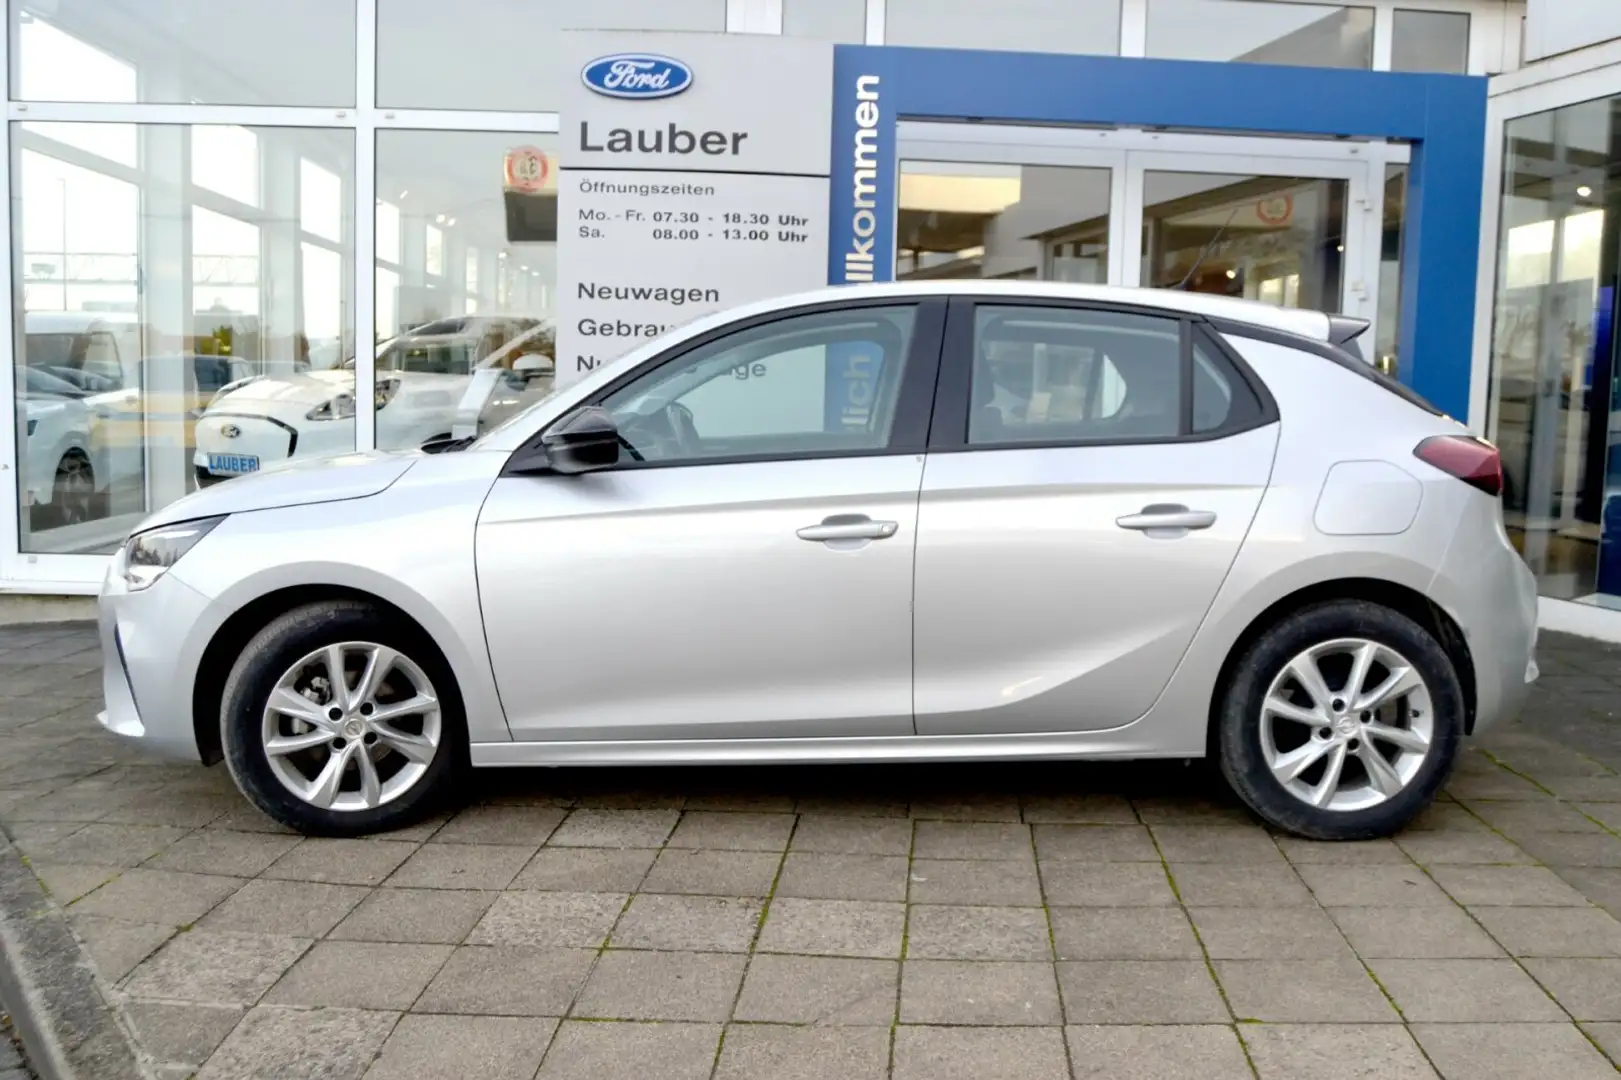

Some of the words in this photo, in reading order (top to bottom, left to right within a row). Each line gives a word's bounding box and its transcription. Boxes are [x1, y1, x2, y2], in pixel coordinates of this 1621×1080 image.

[603, 60, 672, 89] Ford
[580, 121, 748, 155] Lauber
[579, 178, 715, 196] Öffnungszeiten
[845, 75, 880, 281] llkommen
[652, 211, 699, 223] 07.30
[723, 212, 770, 225] 18.30
[777, 214, 809, 226] Uhr
[578, 225, 605, 238] Sa.
[652, 228, 699, 240] 08.00
[723, 229, 770, 241] 13.00
[777, 230, 808, 243] Uhr
[577, 282, 720, 305] Neuwagen
[842, 355, 871, 425] lich
[209, 454, 257, 473] LAUBER
